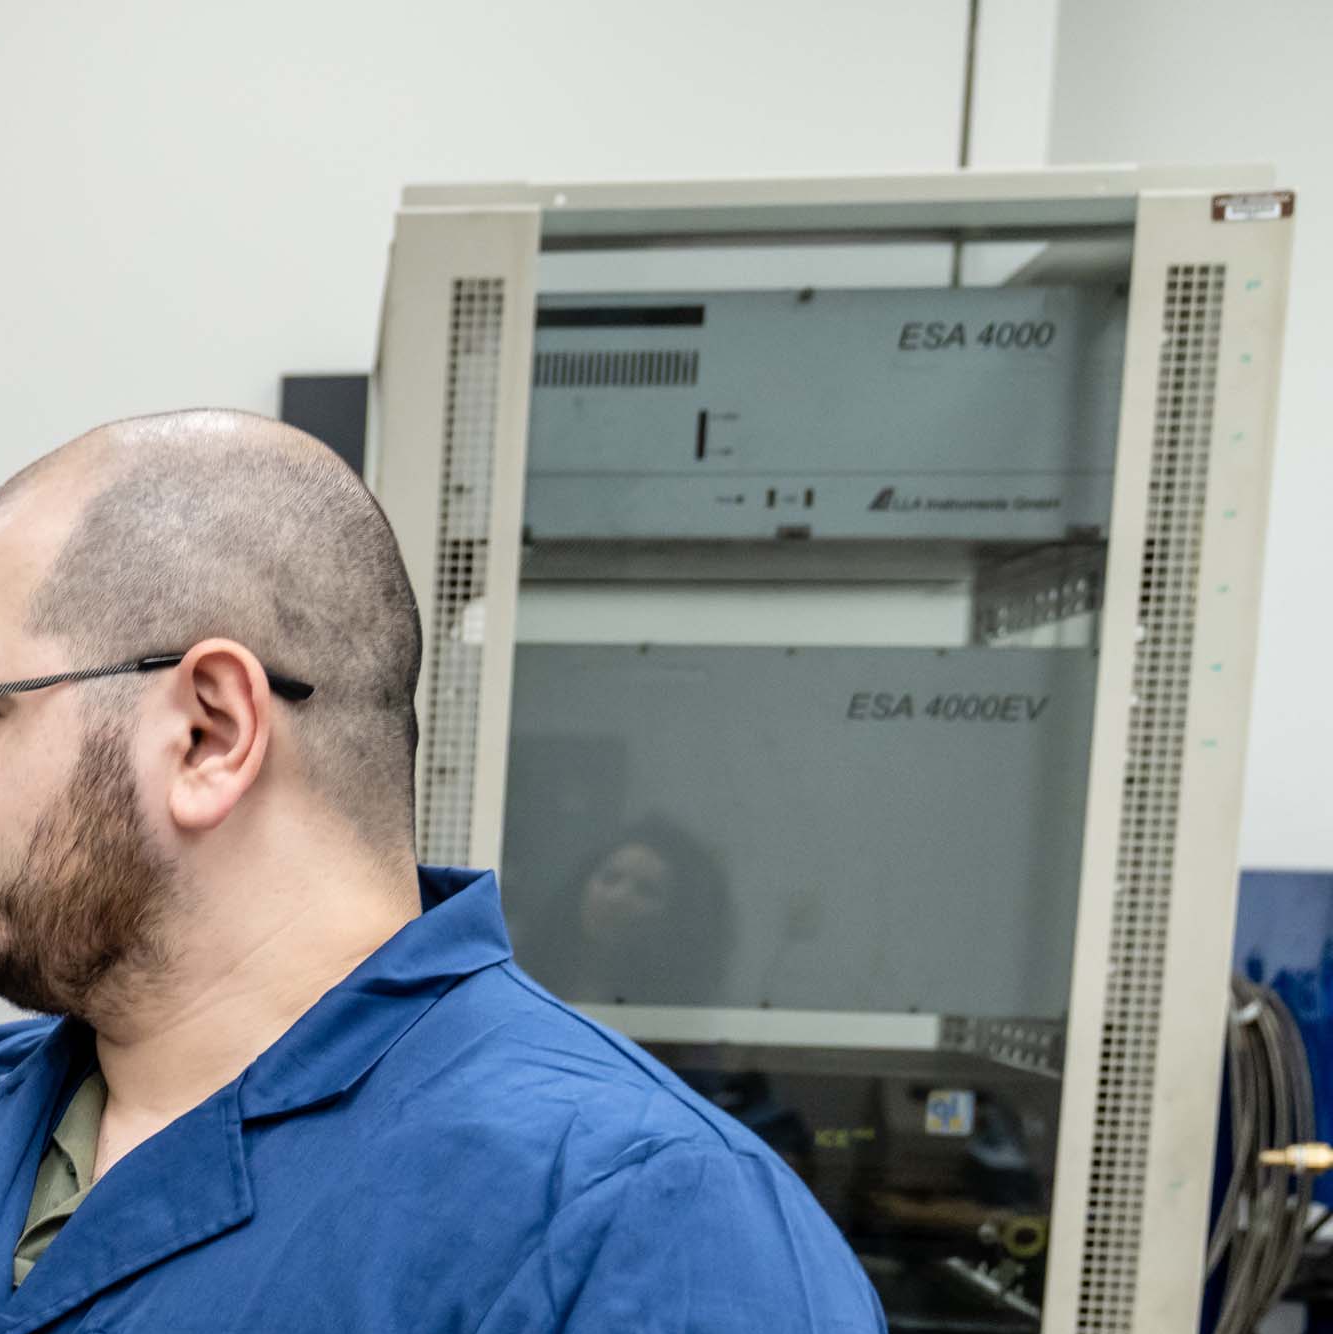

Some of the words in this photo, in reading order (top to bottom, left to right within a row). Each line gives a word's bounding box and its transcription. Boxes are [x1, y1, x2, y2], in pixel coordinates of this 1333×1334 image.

[898, 322, 966, 350] ESA
[976, 322, 1056, 349] 4000
[846, 692, 915, 720] ESA
[923, 692, 1052, 721] 4000EV
